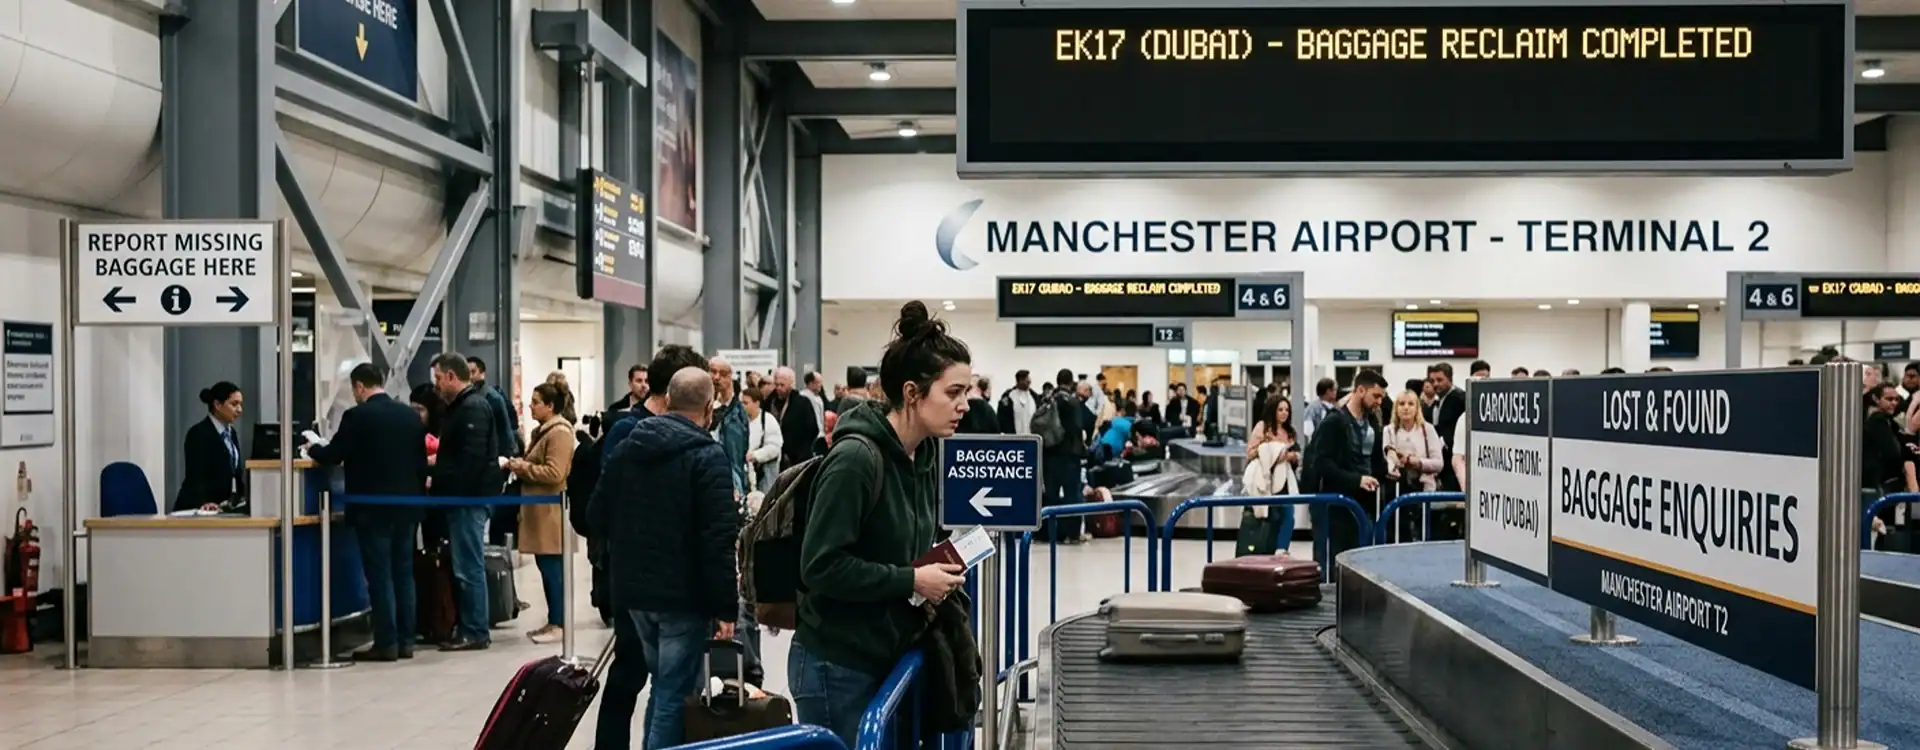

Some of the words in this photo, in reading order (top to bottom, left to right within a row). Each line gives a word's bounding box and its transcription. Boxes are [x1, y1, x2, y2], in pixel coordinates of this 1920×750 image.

[373, 0, 398, 30] HERE
[1056, 29, 1126, 61] EK17
[1140, 29, 1253, 60] (DUBAI)
[1297, 28, 1428, 60] BAGGAGE
[1442, 28, 1568, 59] RECLAIM
[1582, 27, 1752, 59] COMPLETED
[88, 233, 168, 252] REPORT
[175, 232, 263, 252] MISSING
[987, 220, 1276, 253] MANCHESTER
[1291, 219, 1478, 253] AIRPORT
[1517, 219, 1735, 252] TERMINAL
[1748, 219, 1769, 252] 2
[95, 257, 196, 277] BAGGAGE
[204, 257, 256, 276] HERE
[1241, 288, 1256, 306] 4
[1259, 292, 1270, 306] &
[1273, 287, 1287, 306] 6
[1749, 288, 1763, 306] 4
[1766, 292, 1777, 306] &
[1781, 287, 1794, 306] 6
[1479, 391, 1531, 424] CAROUSEL
[1533, 392, 1541, 425] 5
[1602, 389, 1642, 431] LOST
[1645, 390, 1659, 432] &
[1663, 388, 1731, 435] FOUND
[947, 465, 1033, 479] ASSISTANCE
[956, 449, 1025, 463] BAGGAGE
[1478, 444, 1513, 473] ARRIVALS
[1514, 448, 1542, 477] FROM:
[1502, 493, 1539, 538] (DUBAI)
[1561, 465, 1653, 532] BAGGAGE
[1660, 478, 1800, 563] ENQUIRIES
[1601, 569, 1663, 613] MANCHESTER
[1664, 589, 1712, 630] AIRPORT
[1713, 603, 1729, 636] T2
